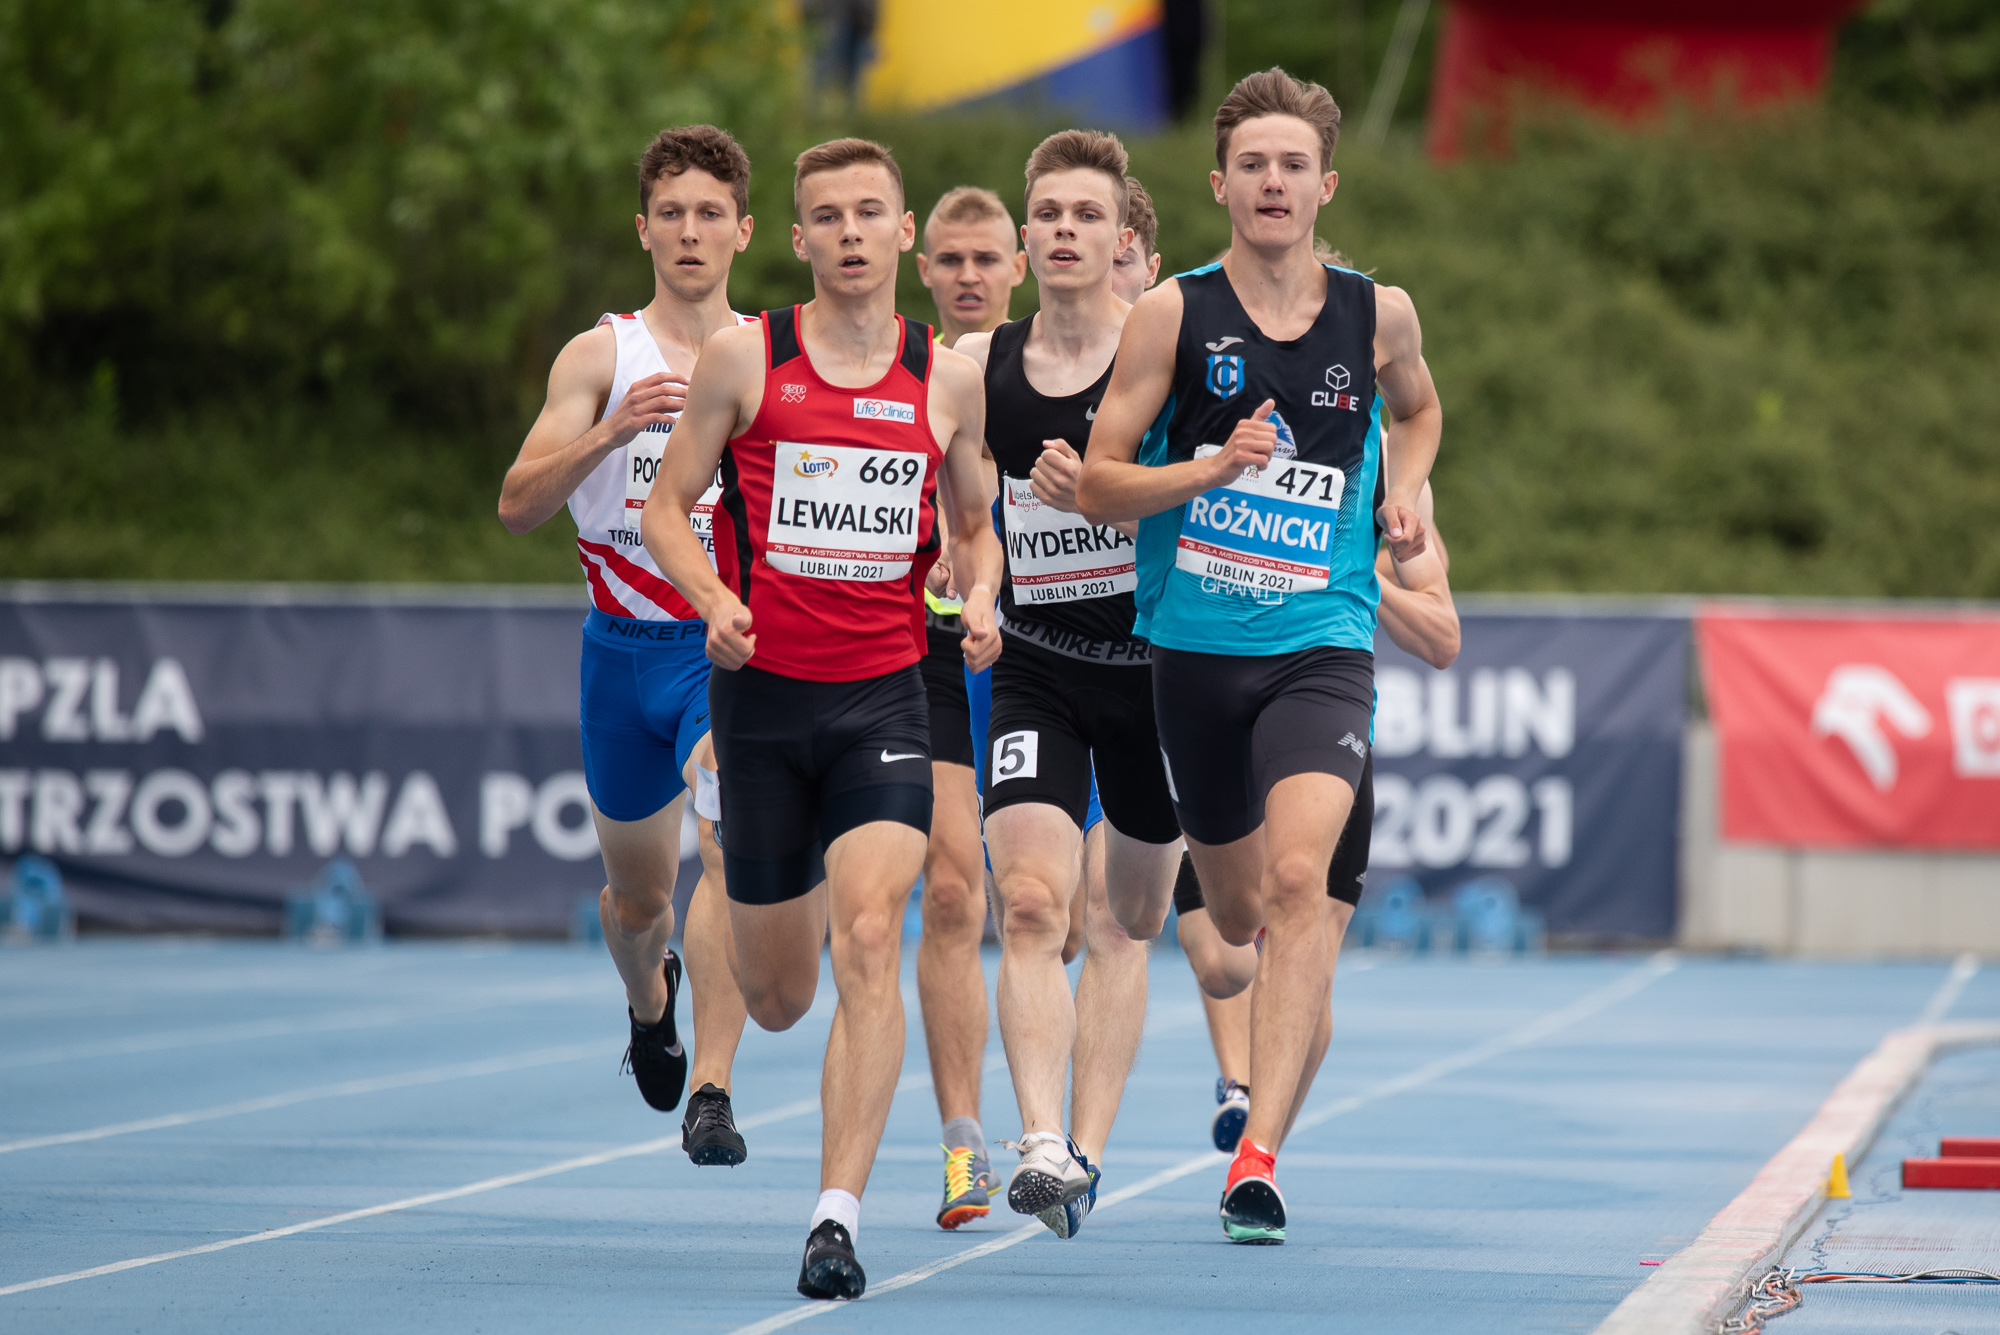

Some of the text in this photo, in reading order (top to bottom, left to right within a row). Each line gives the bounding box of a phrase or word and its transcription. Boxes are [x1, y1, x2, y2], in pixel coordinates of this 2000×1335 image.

[856, 403, 914, 420] Life clinica
[1311, 391, 1359, 411] CUBE
[802, 456, 919, 486] LOTTO 669
[1275, 467, 1333, 502] 471
[777, 497, 913, 535] LEWALSKI
[1190, 496, 1331, 552] RÓŻNICKI
[787, 546, 809, 555] PZLA
[810, 549, 867, 560] MISTRZOSTWA
[868, 553, 895, 561] POLSKI
[1008, 525, 1134, 560] WYDERKA
[800, 561, 884, 579] LUBLIN 2021
[1036, 571, 1092, 583] MISTRZOSTWA
[1093, 568, 1121, 576] POLSKI
[1197, 544, 1218, 556] PZLA
[1218, 550, 1277, 569] MISTRZOSTWA
[1277, 564, 1306, 574] POLSKI
[1306, 569, 1324, 577] U20
[1206, 560, 1294, 592] LUBLIN 2021
[1030, 580, 1115, 601] LUBLIN 2021
[607, 619, 677, 641] NIKE
[1039, 623, 1105, 659] NIKE
[0, 656, 204, 744] PZLA
[998, 735, 1026, 776] 5
[1370, 773, 1575, 869] 2021
